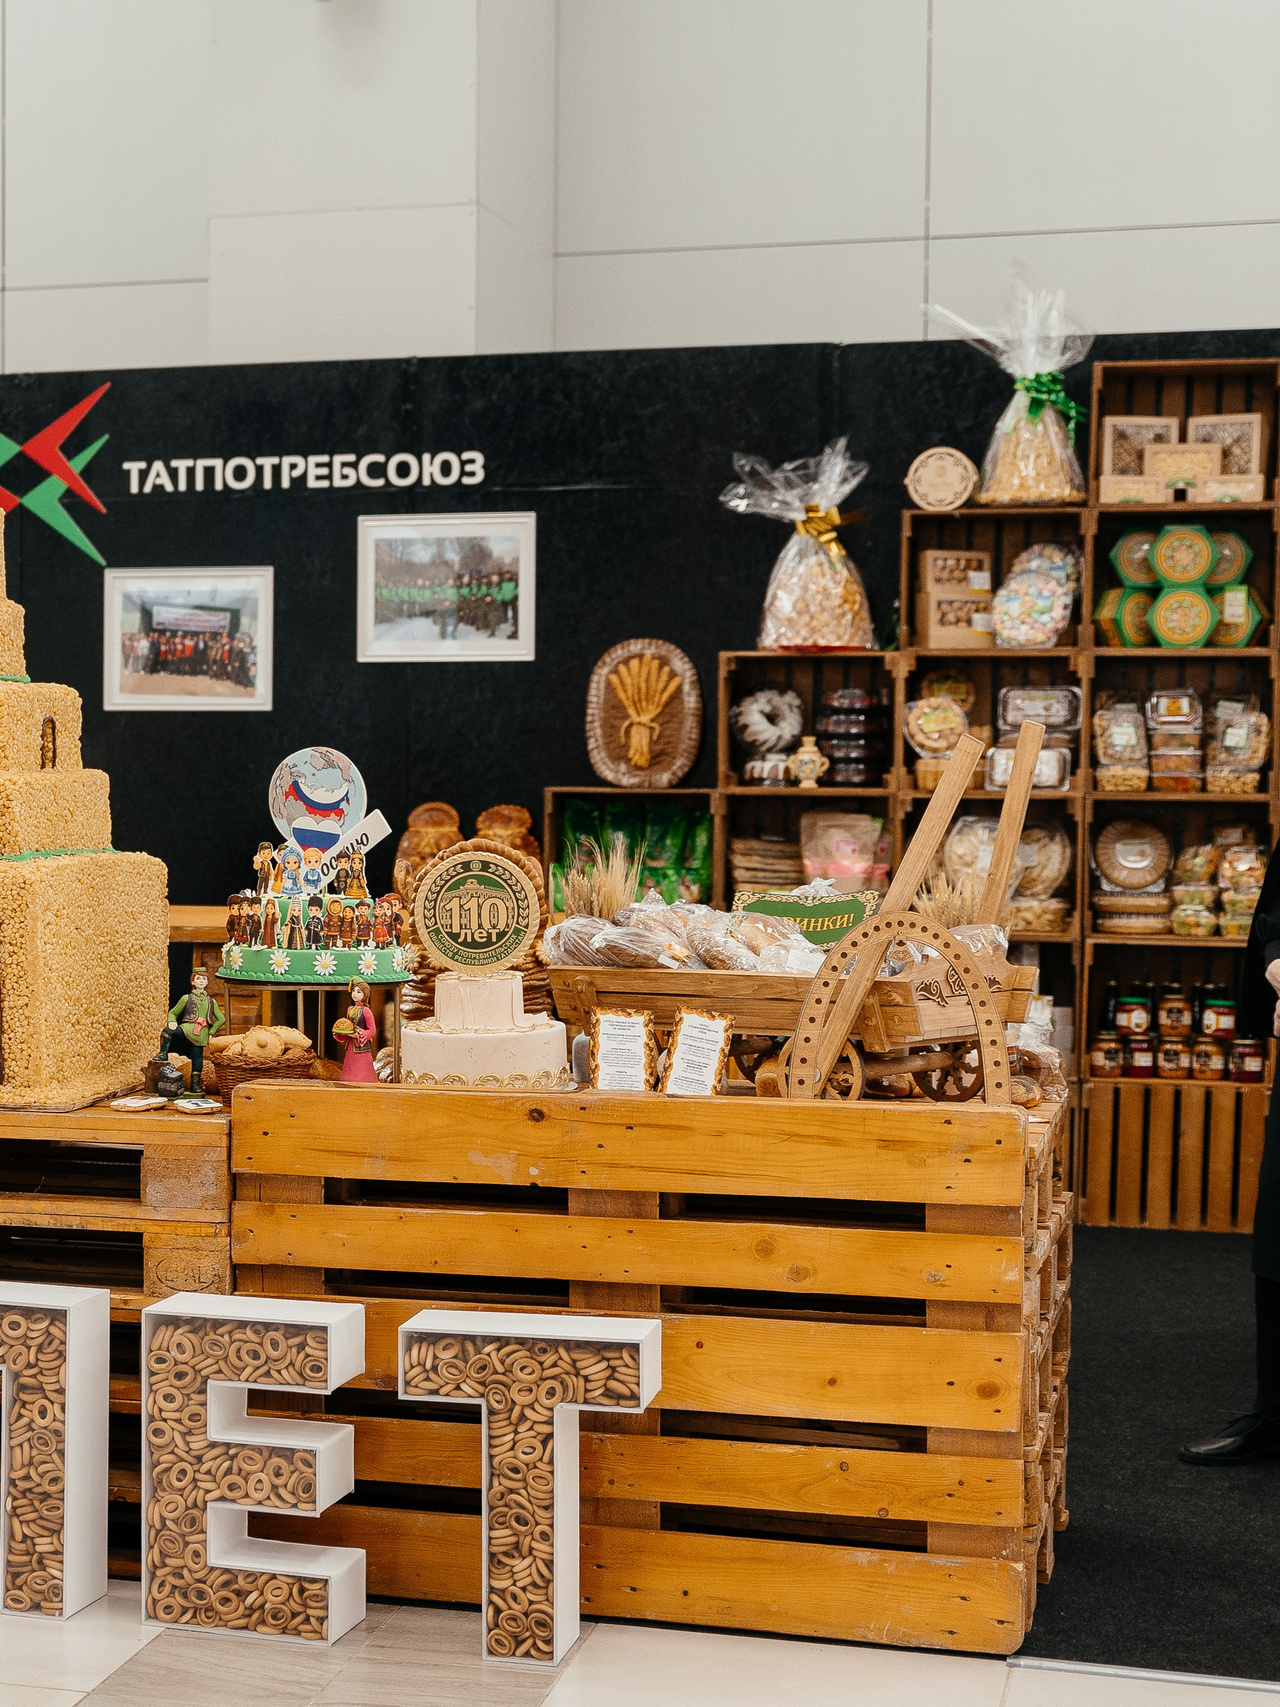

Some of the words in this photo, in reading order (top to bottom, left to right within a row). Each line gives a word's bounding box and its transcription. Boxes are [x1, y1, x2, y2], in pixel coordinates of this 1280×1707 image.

[122, 452, 486, 494] ТАТПОТРЕБСОЮЗ
[444, 896, 508, 934] 110
[429, 932, 452, 958] ОБЩЕСТВ
[454, 955, 497, 965] РЕСПУБЛИКИ
[497, 931, 526, 960] ТАТАРСТАН
[438, 934, 458, 954] СОЮЗУ
[458, 934, 518, 959] ПОТРЕБИТЕЛЬСКИХ
[458, 928, 500, 942] лет
